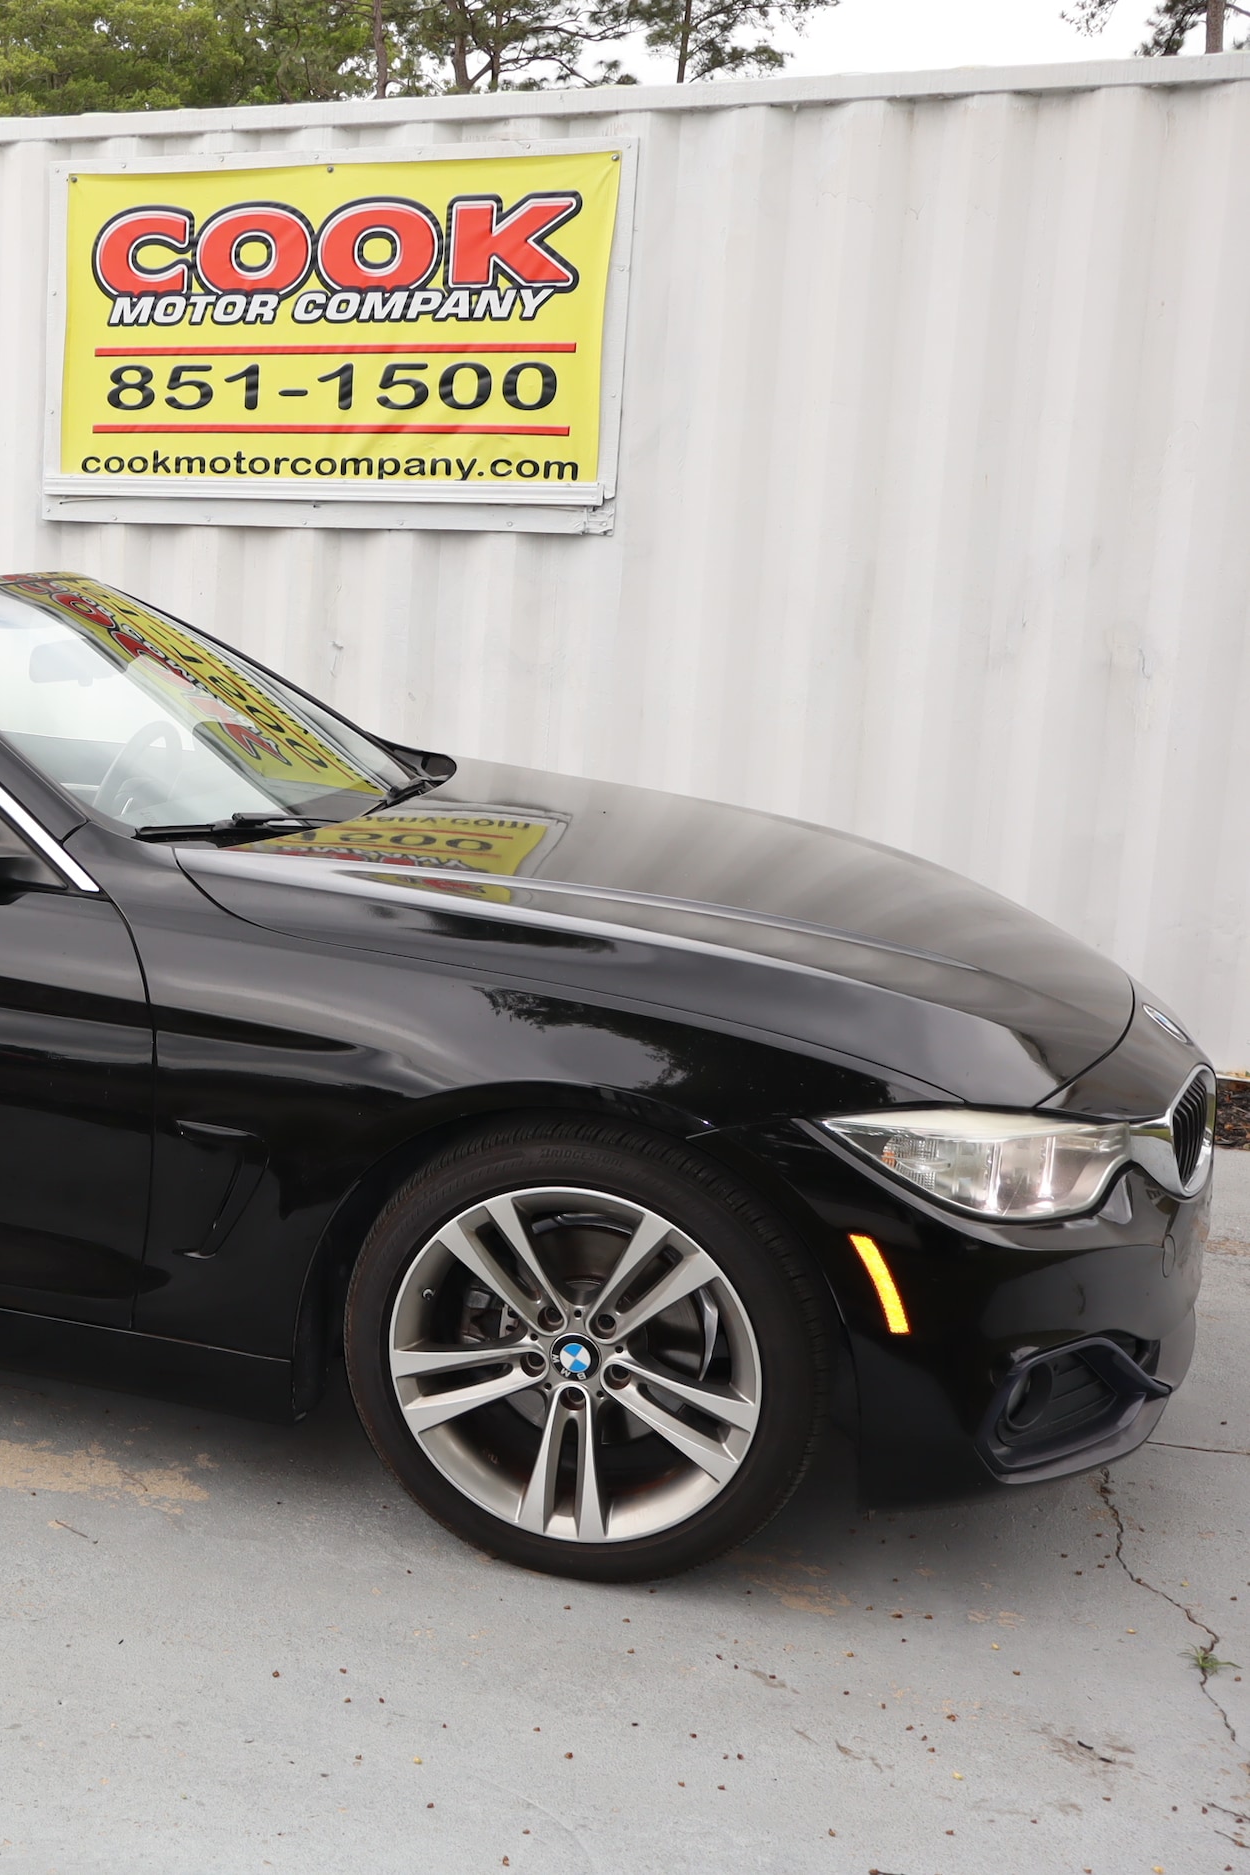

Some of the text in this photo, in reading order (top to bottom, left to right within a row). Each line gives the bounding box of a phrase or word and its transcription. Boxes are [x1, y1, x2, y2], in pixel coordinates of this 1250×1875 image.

[92, 191, 582, 297] COOK
[108, 287, 553, 326] MOTOR COMPANY
[106, 361, 558, 411] 851-1500
[81, 450, 579, 481] cookmotorcompany.com
[551, 1353, 587, 1380] BMW
